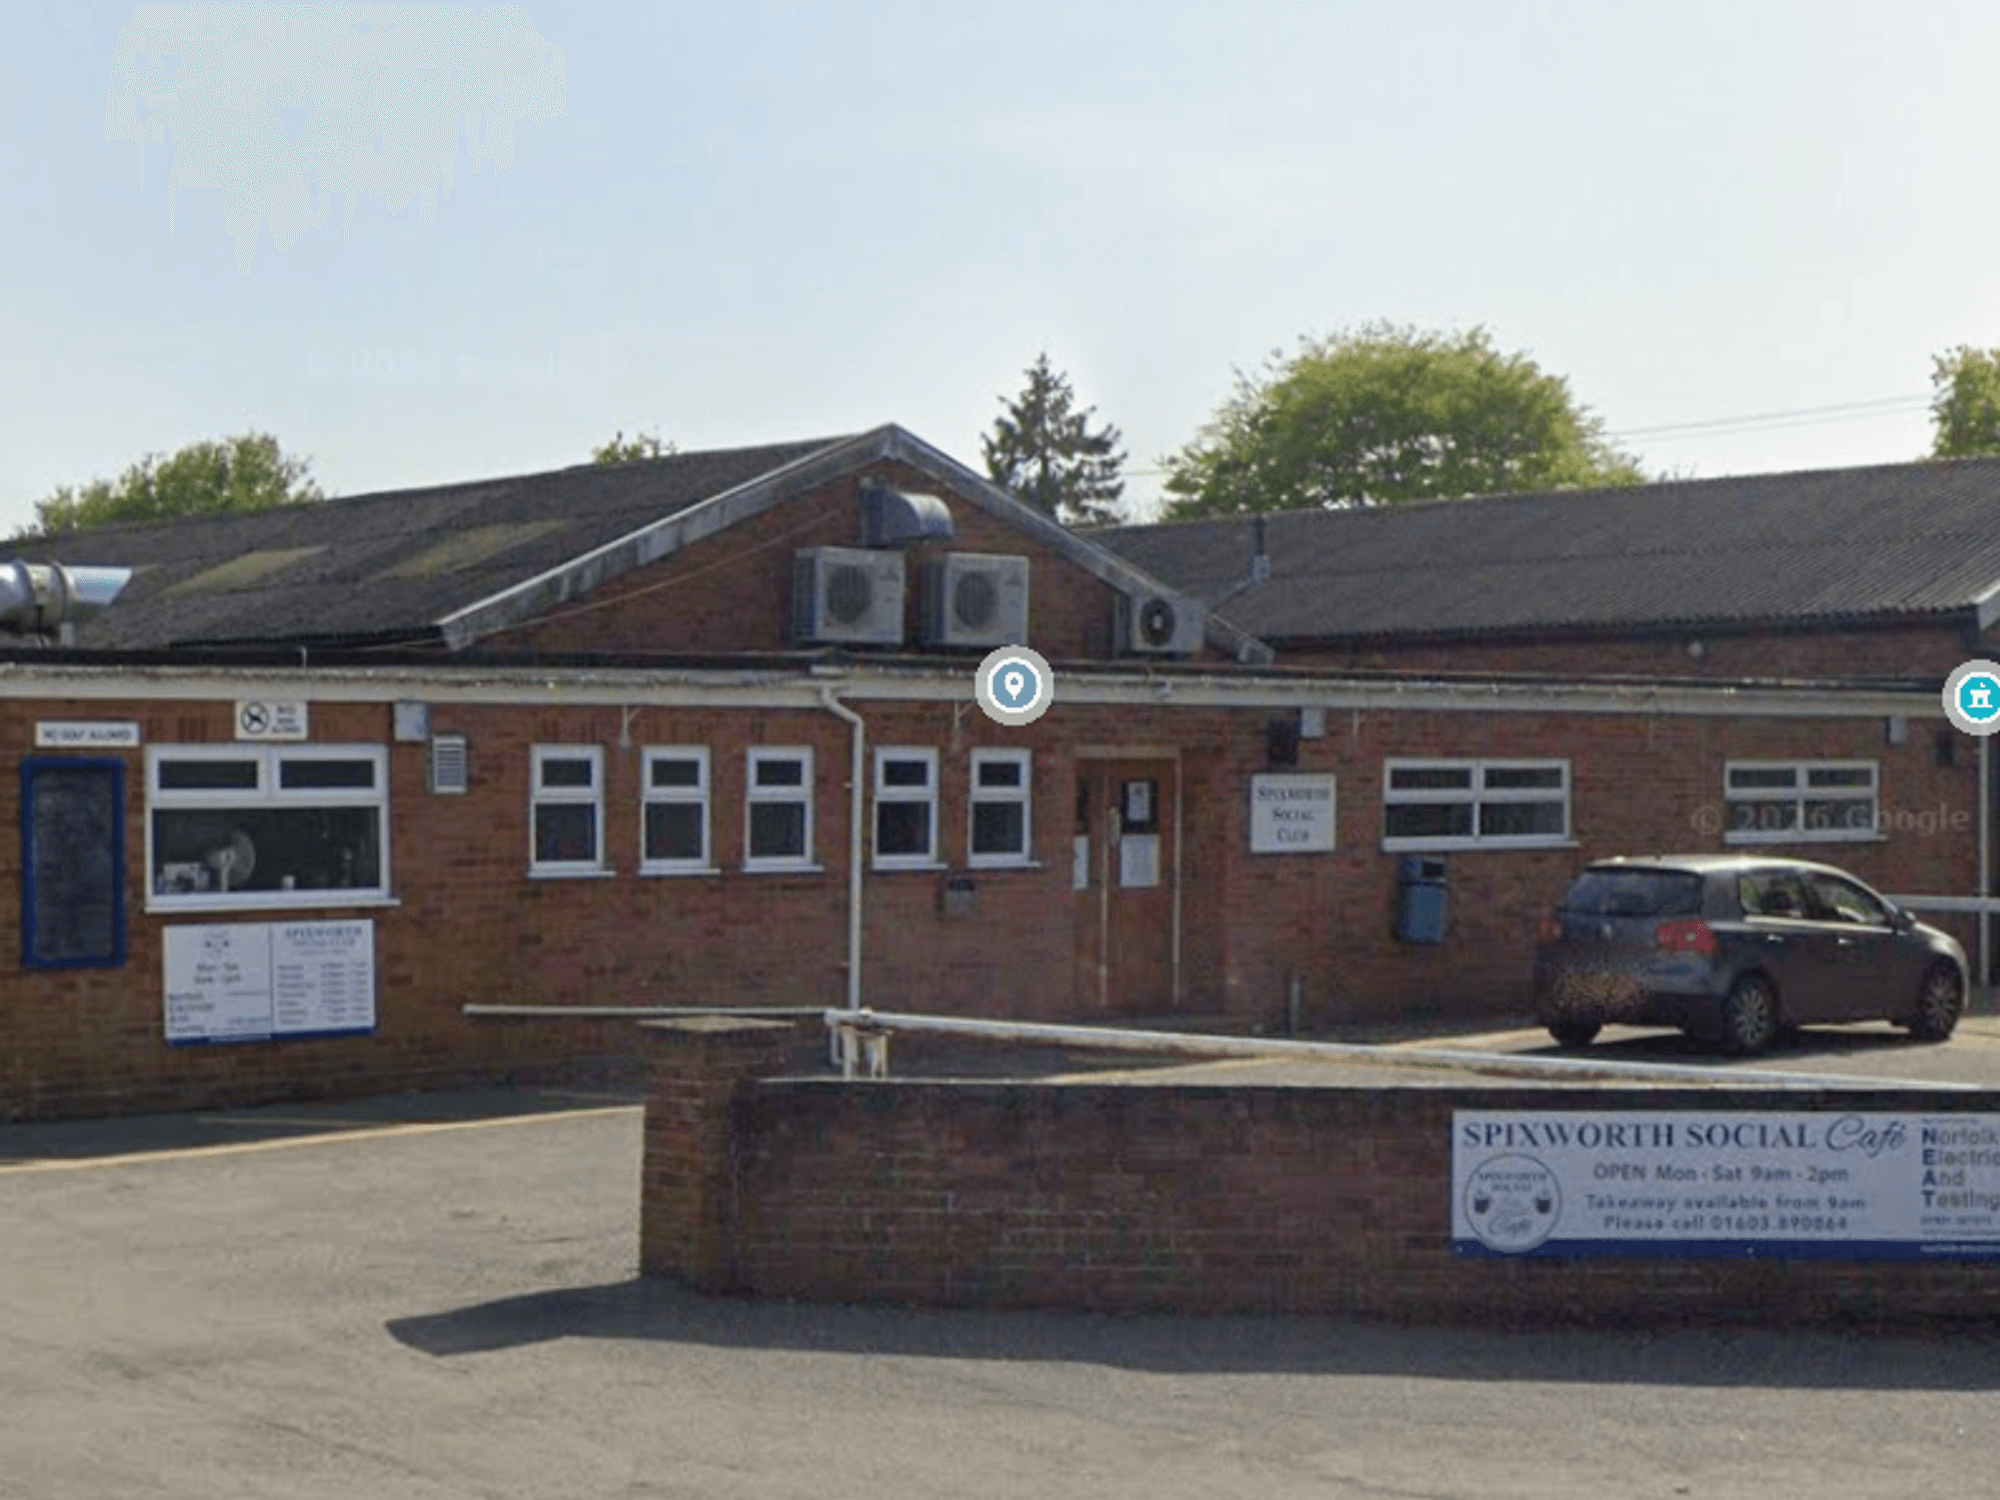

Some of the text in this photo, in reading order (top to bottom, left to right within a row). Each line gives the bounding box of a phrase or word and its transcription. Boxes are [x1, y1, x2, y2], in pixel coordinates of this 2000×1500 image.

[1463, 1122, 1674, 1149] SPIXWORTH
[1684, 1122, 1816, 1149] SOCIAL
[1593, 1163, 1645, 1182] OPEN
[1656, 1164, 1697, 1182] Mon
[1713, 1164, 1743, 1182] Sat
[1750, 1165, 1792, 1183] 9am
[1807, 1166, 1849, 1186] 2pm
[1922, 1168, 1965, 1187] And
[1586, 1194, 1865, 1212] Takeaway available from 9am
[1603, 1215, 1665, 1230] Please
[1670, 1215, 1703, 1230] call
[1710, 1216, 1770, 1231] 01603
